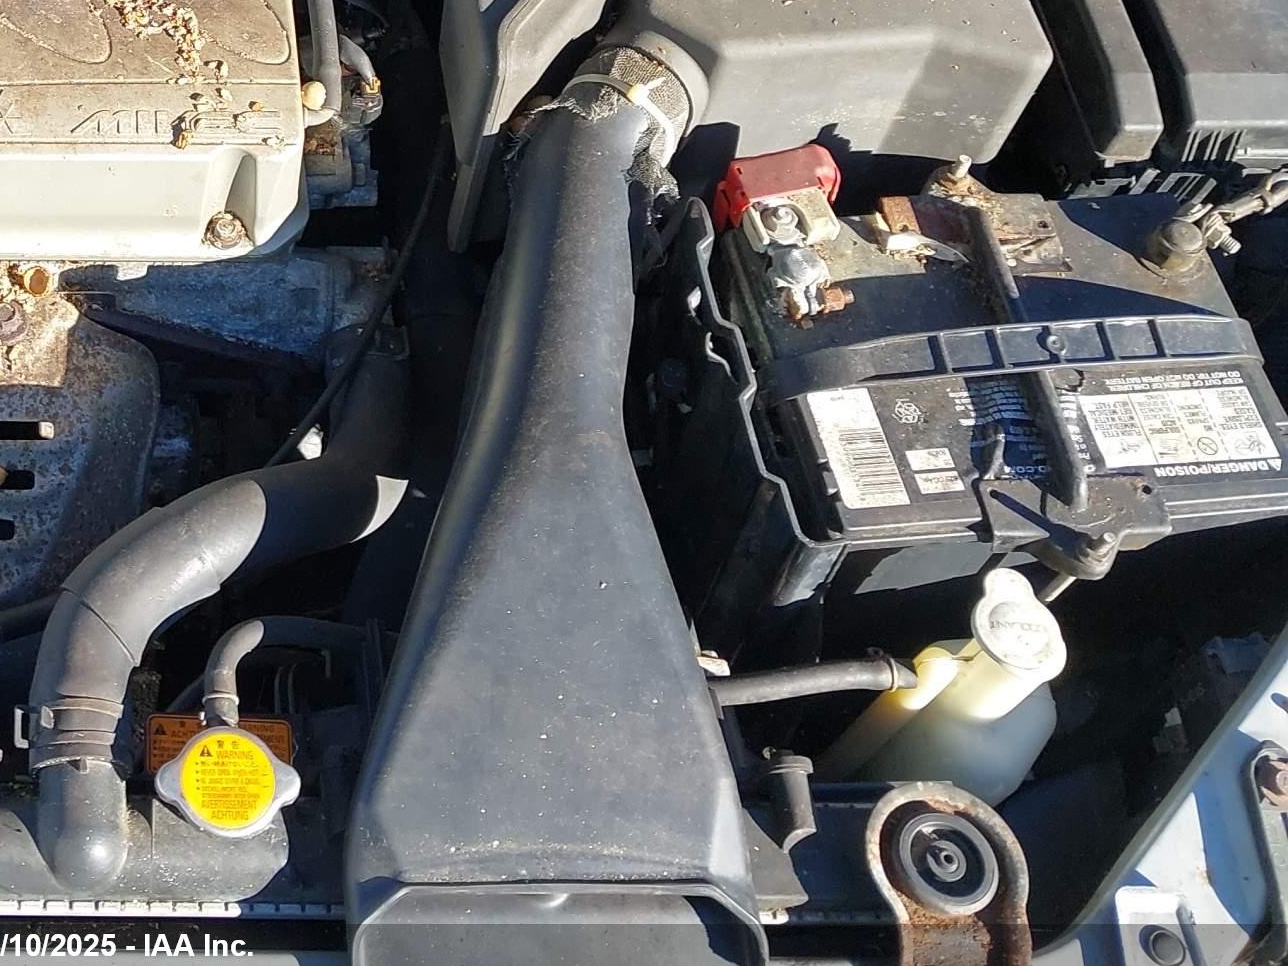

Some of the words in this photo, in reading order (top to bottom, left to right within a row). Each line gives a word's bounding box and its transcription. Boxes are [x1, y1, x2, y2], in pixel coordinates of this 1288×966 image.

[1154, 460, 1269, 477] DANGER/POISON
[215, 750, 254, 760] WARNING
[201, 800, 257, 810] AVERTISSEMENT
[211, 810, 249, 821] ACHTUNG
